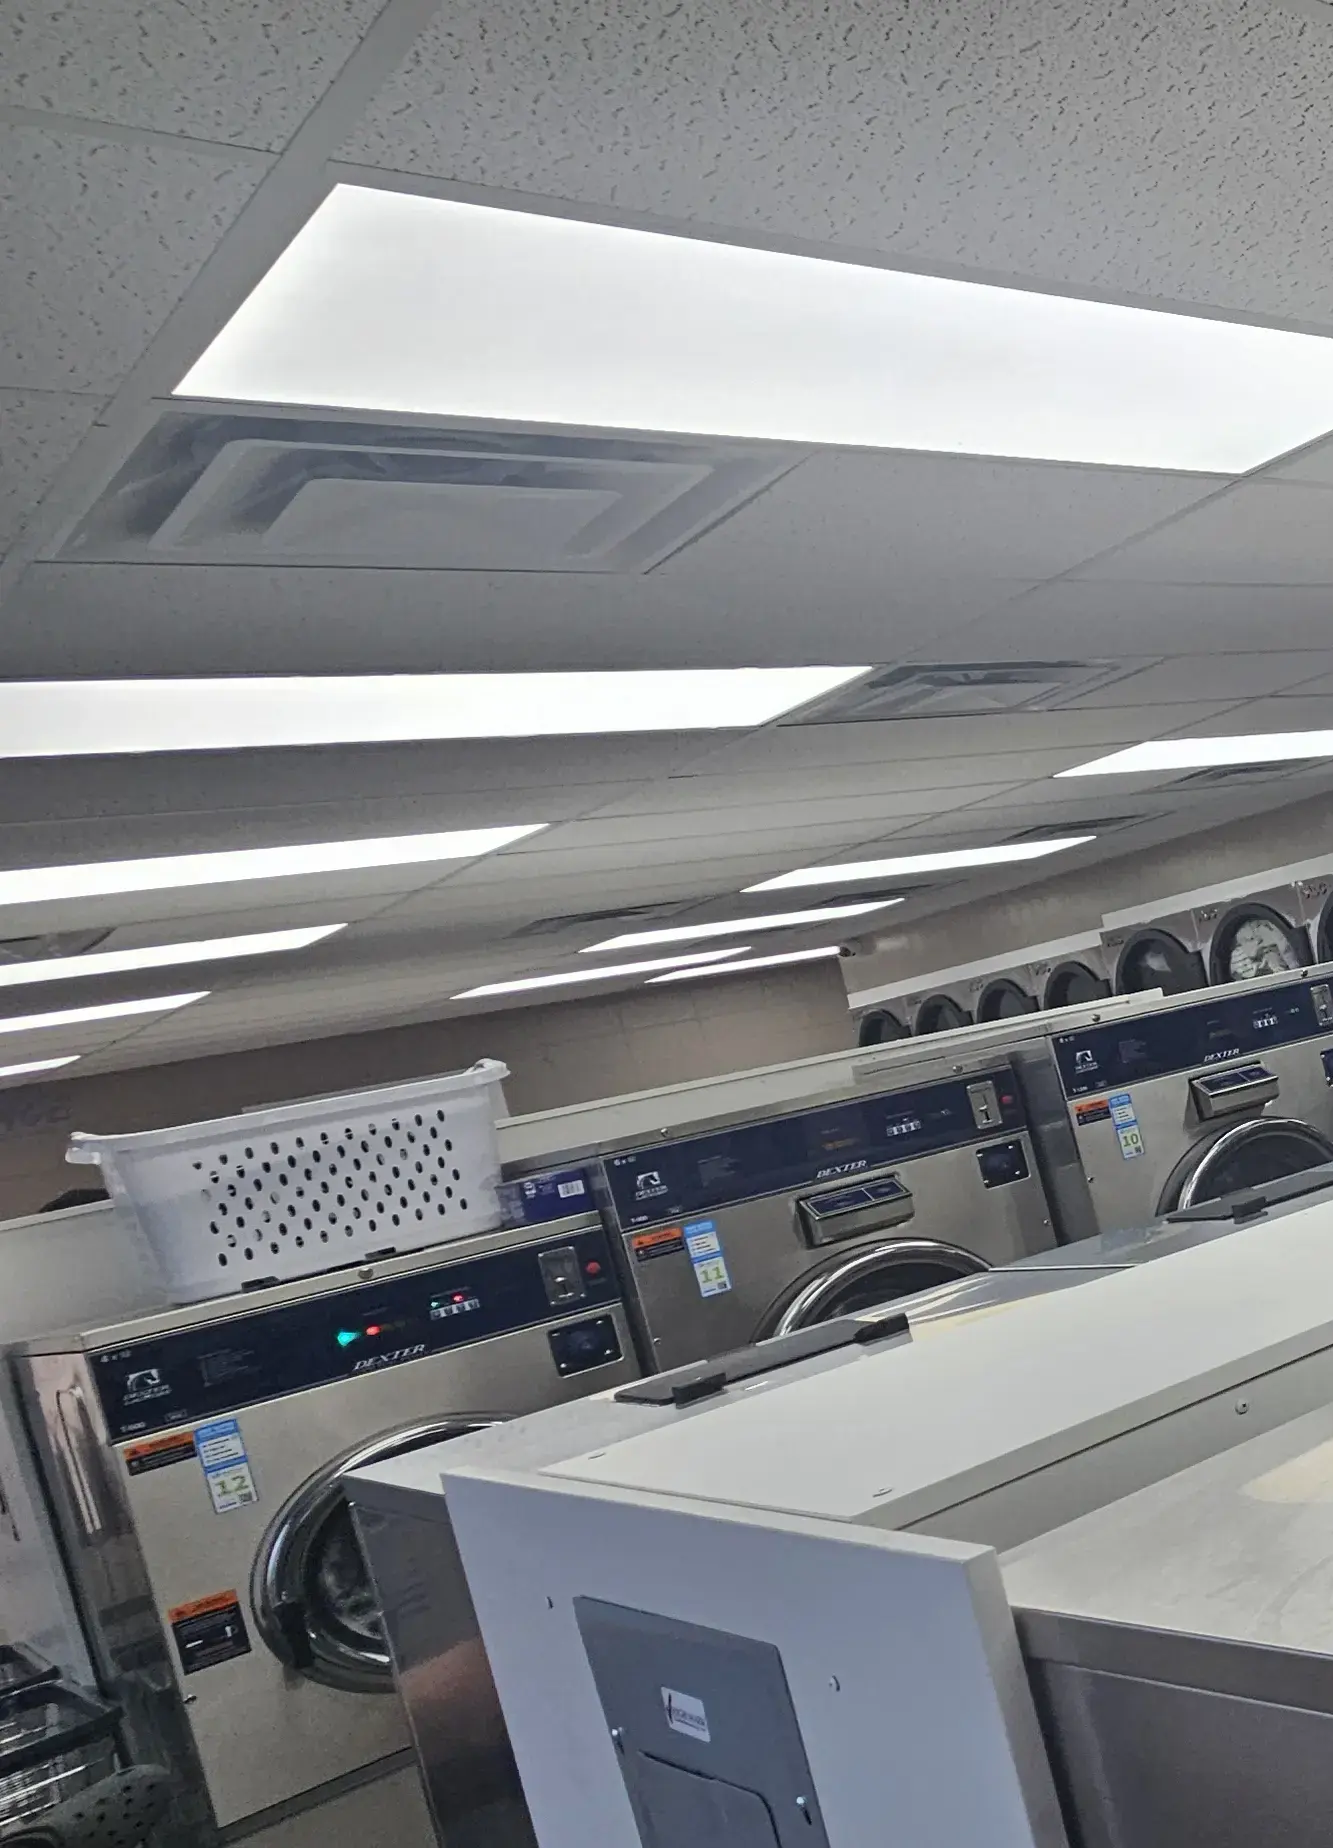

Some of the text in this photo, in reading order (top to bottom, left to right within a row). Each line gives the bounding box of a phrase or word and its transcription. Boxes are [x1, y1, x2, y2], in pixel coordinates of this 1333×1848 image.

[1203, 1048, 1240, 1063] DEXTER
[1122, 1133, 1140, 1147] 10
[816, 1159, 868, 1180] DEXTER
[700, 1269, 725, 1284] 11
[351, 1343, 427, 1371] DEXTER
[216, 1475, 250, 1498] 12
